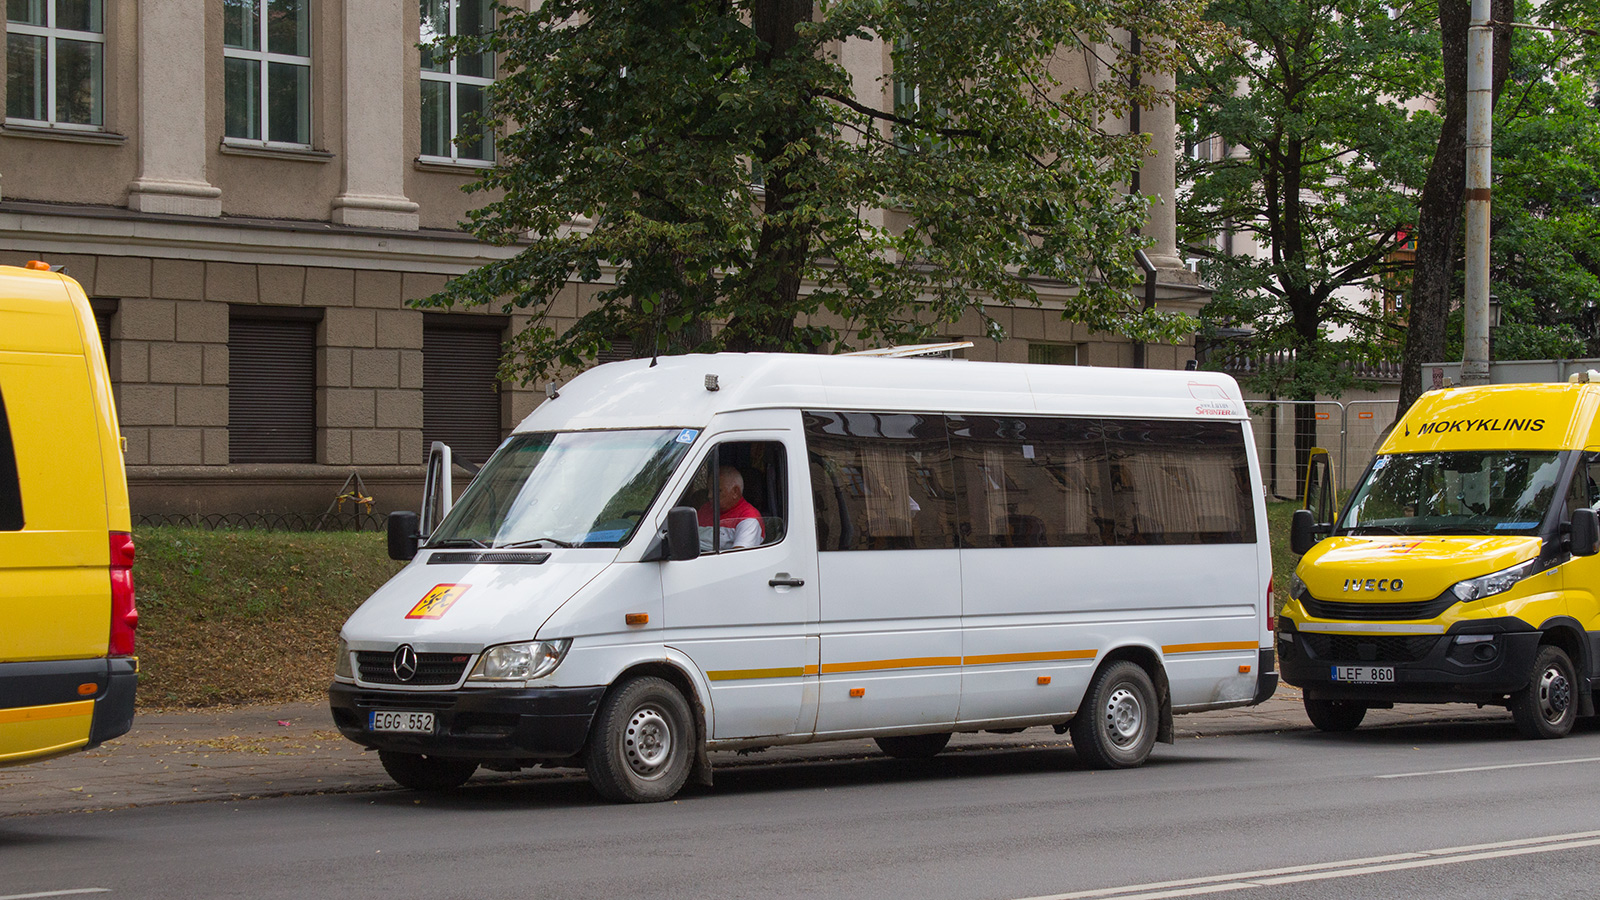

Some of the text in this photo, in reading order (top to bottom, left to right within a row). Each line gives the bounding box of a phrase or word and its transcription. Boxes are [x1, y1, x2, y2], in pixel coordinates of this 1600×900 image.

[1417, 418, 1546, 435] MOKYKLINIS
[1343, 578, 1404, 592] IVECO
[1338, 667, 1363, 680] LEF
[1371, 668, 1393, 680] 860
[374, 713, 433, 731] EGG 552
